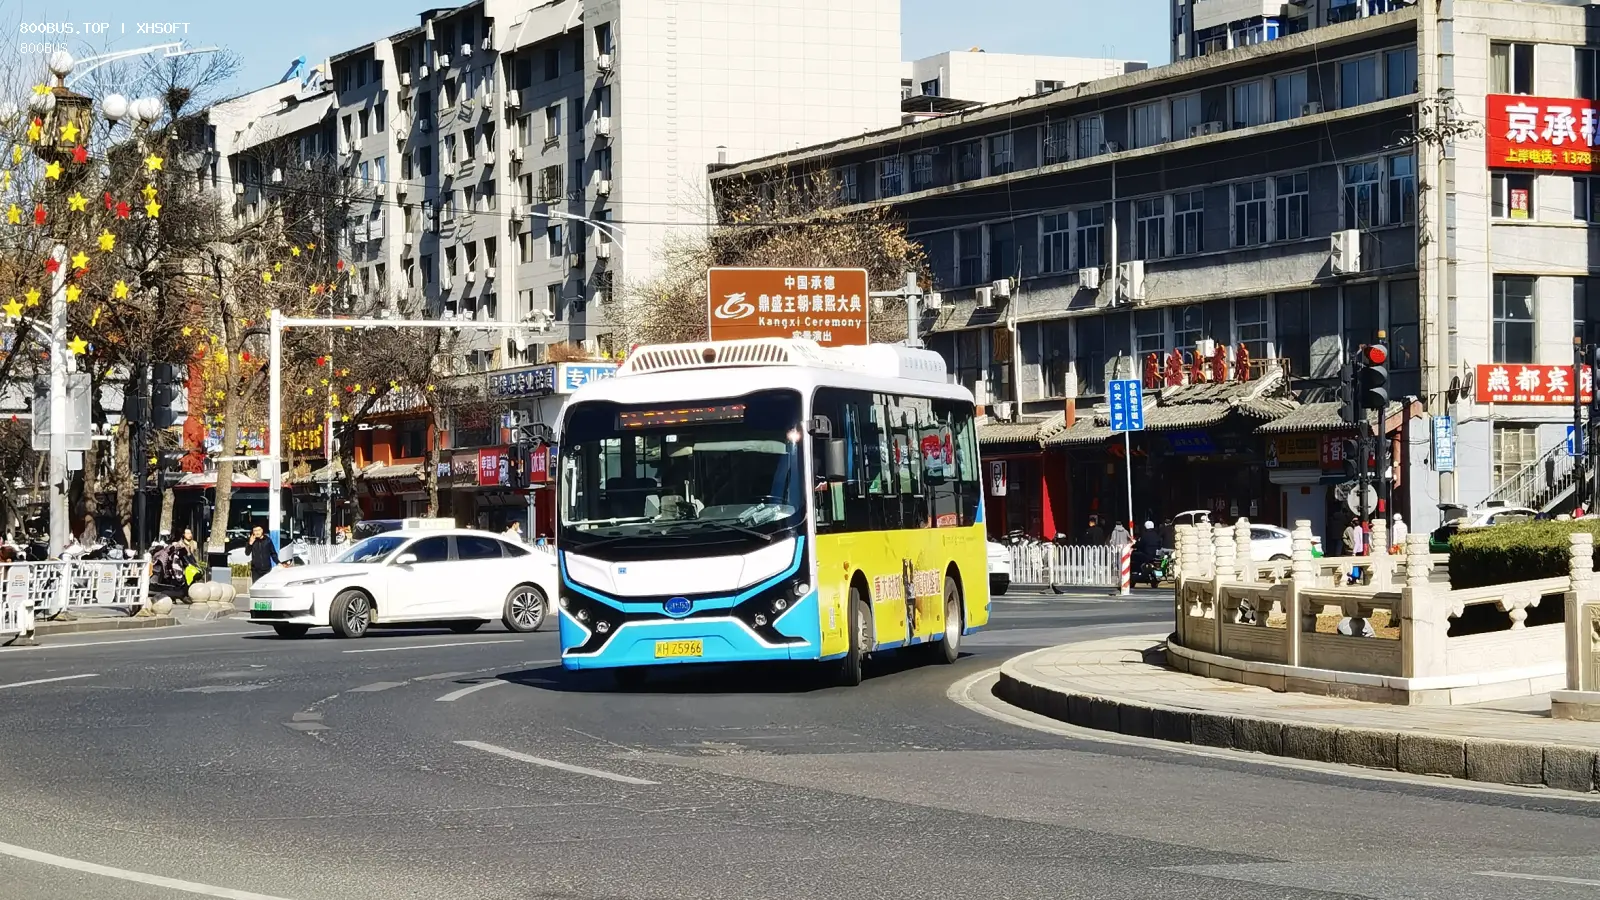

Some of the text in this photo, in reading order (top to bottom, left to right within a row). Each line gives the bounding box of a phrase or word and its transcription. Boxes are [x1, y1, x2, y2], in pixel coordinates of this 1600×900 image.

[784, 275, 836, 290] 中国·承德
[758, 293, 862, 313] 鼎盛王朝·康熙大典
[758, 316, 862, 329] Kangxi Ceremony
[1113, 382, 1123, 421] 公交车道
[1128, 382, 1139, 420] 非机动车道
